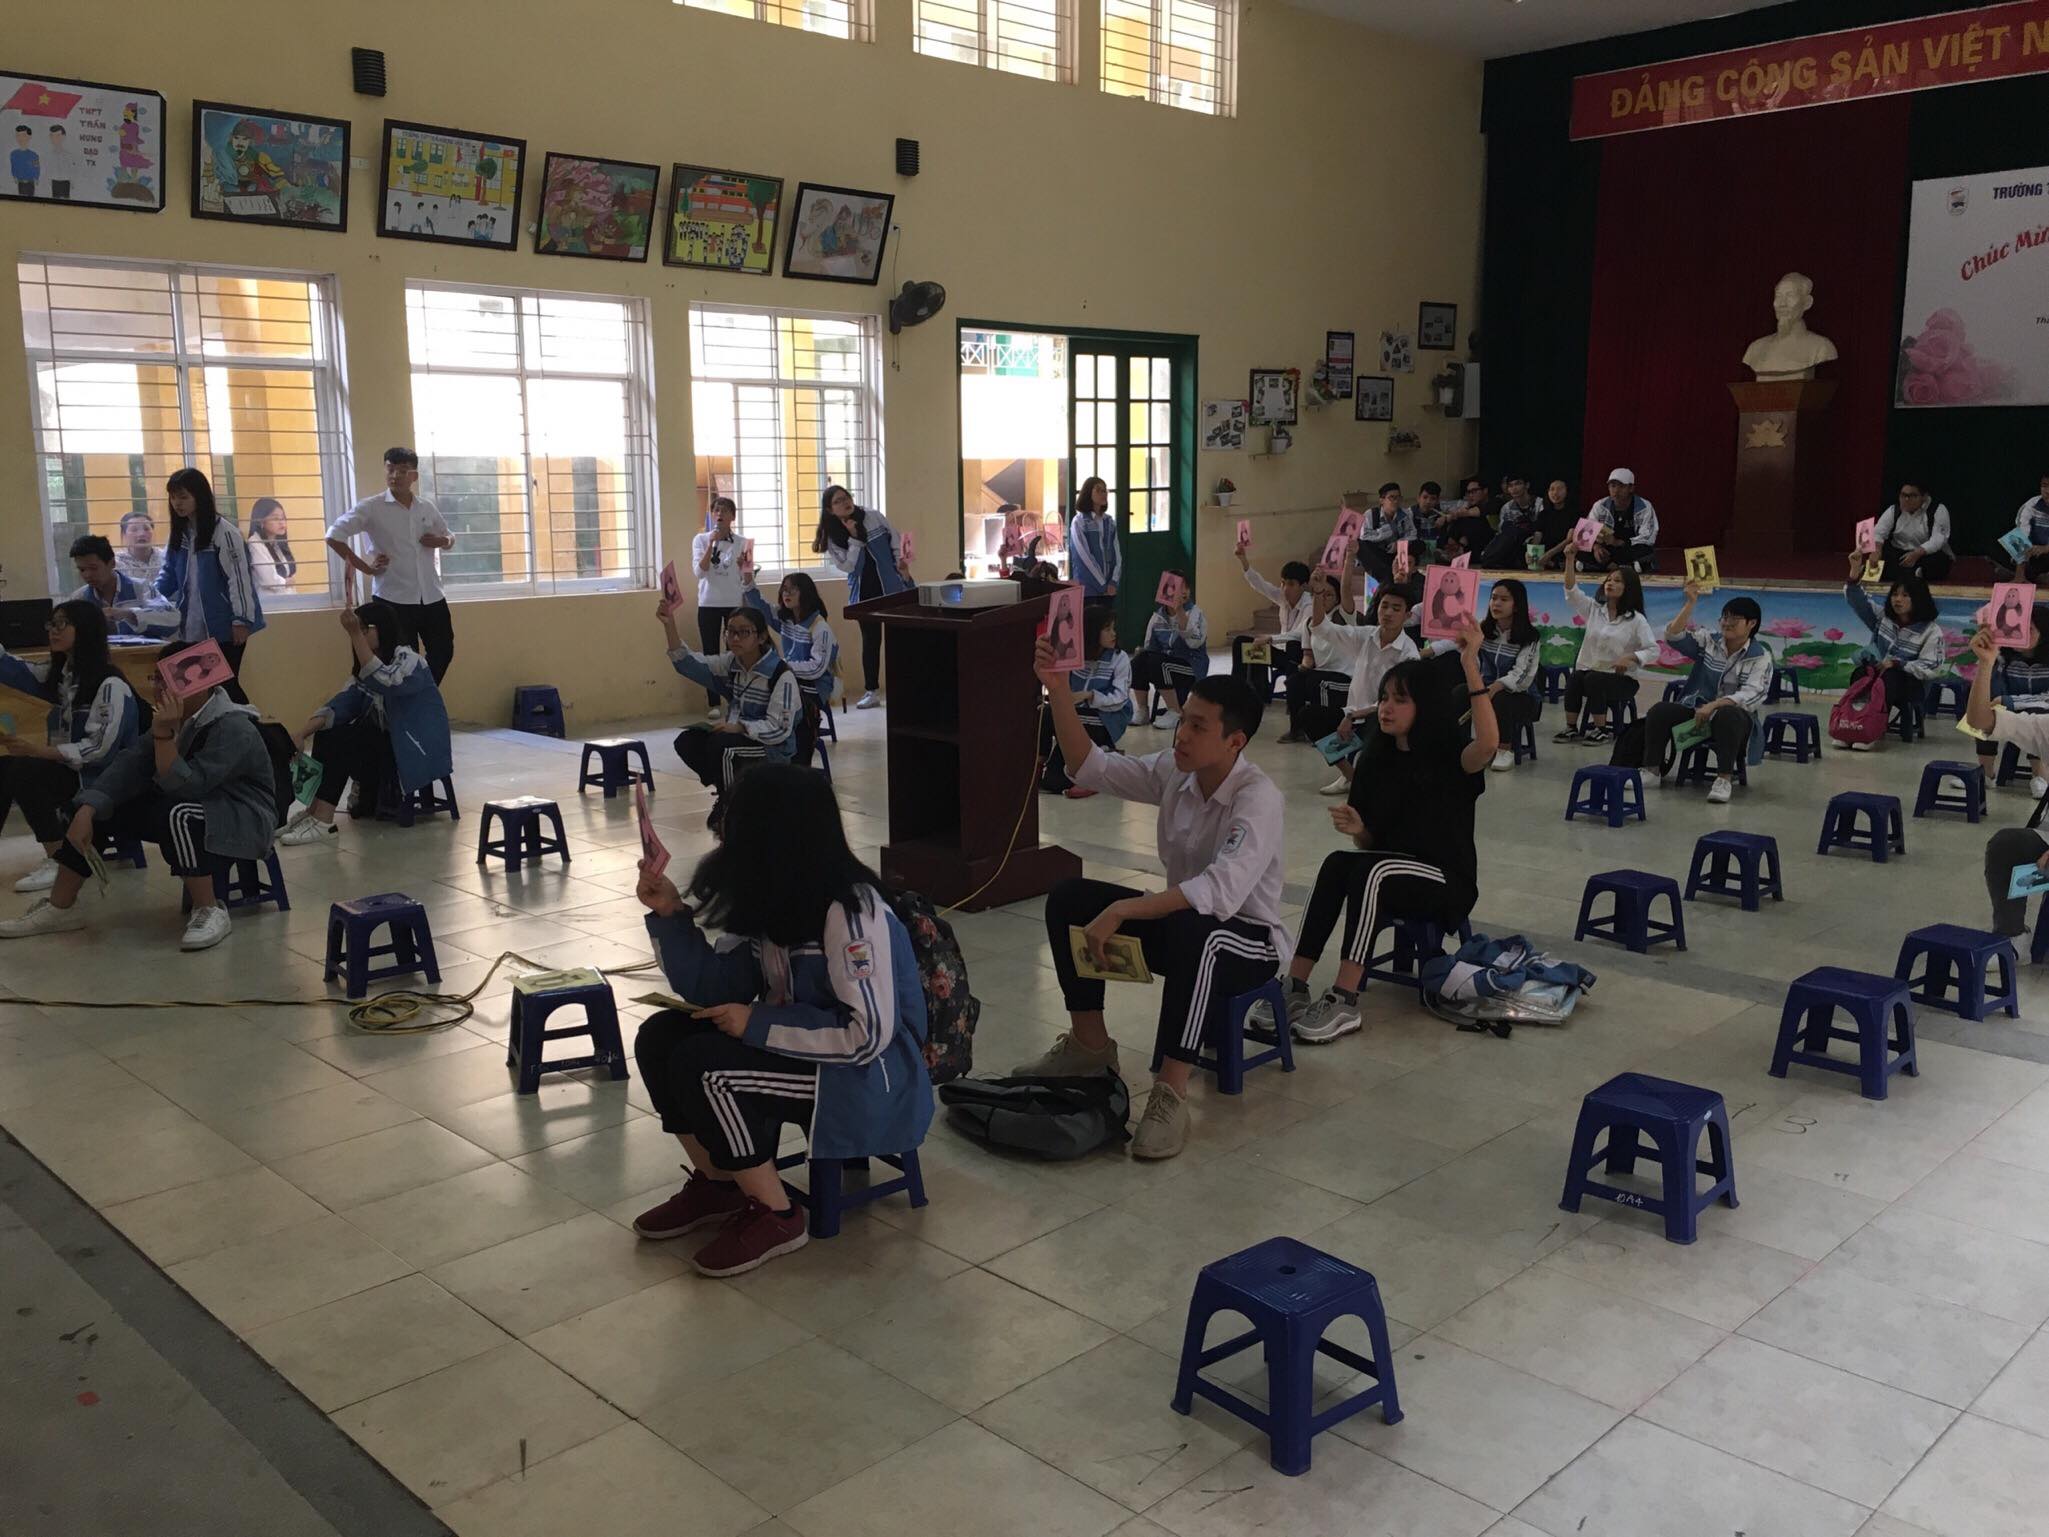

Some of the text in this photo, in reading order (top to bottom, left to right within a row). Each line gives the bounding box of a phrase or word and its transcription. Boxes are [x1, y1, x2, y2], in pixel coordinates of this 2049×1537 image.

[1610, 73, 1705, 118] ĐẢNG
[1716, 57, 1817, 104] CỘNG
[1830, 35, 1910, 84] SẢN
[1922, 24, 2011, 72] VIỆT
